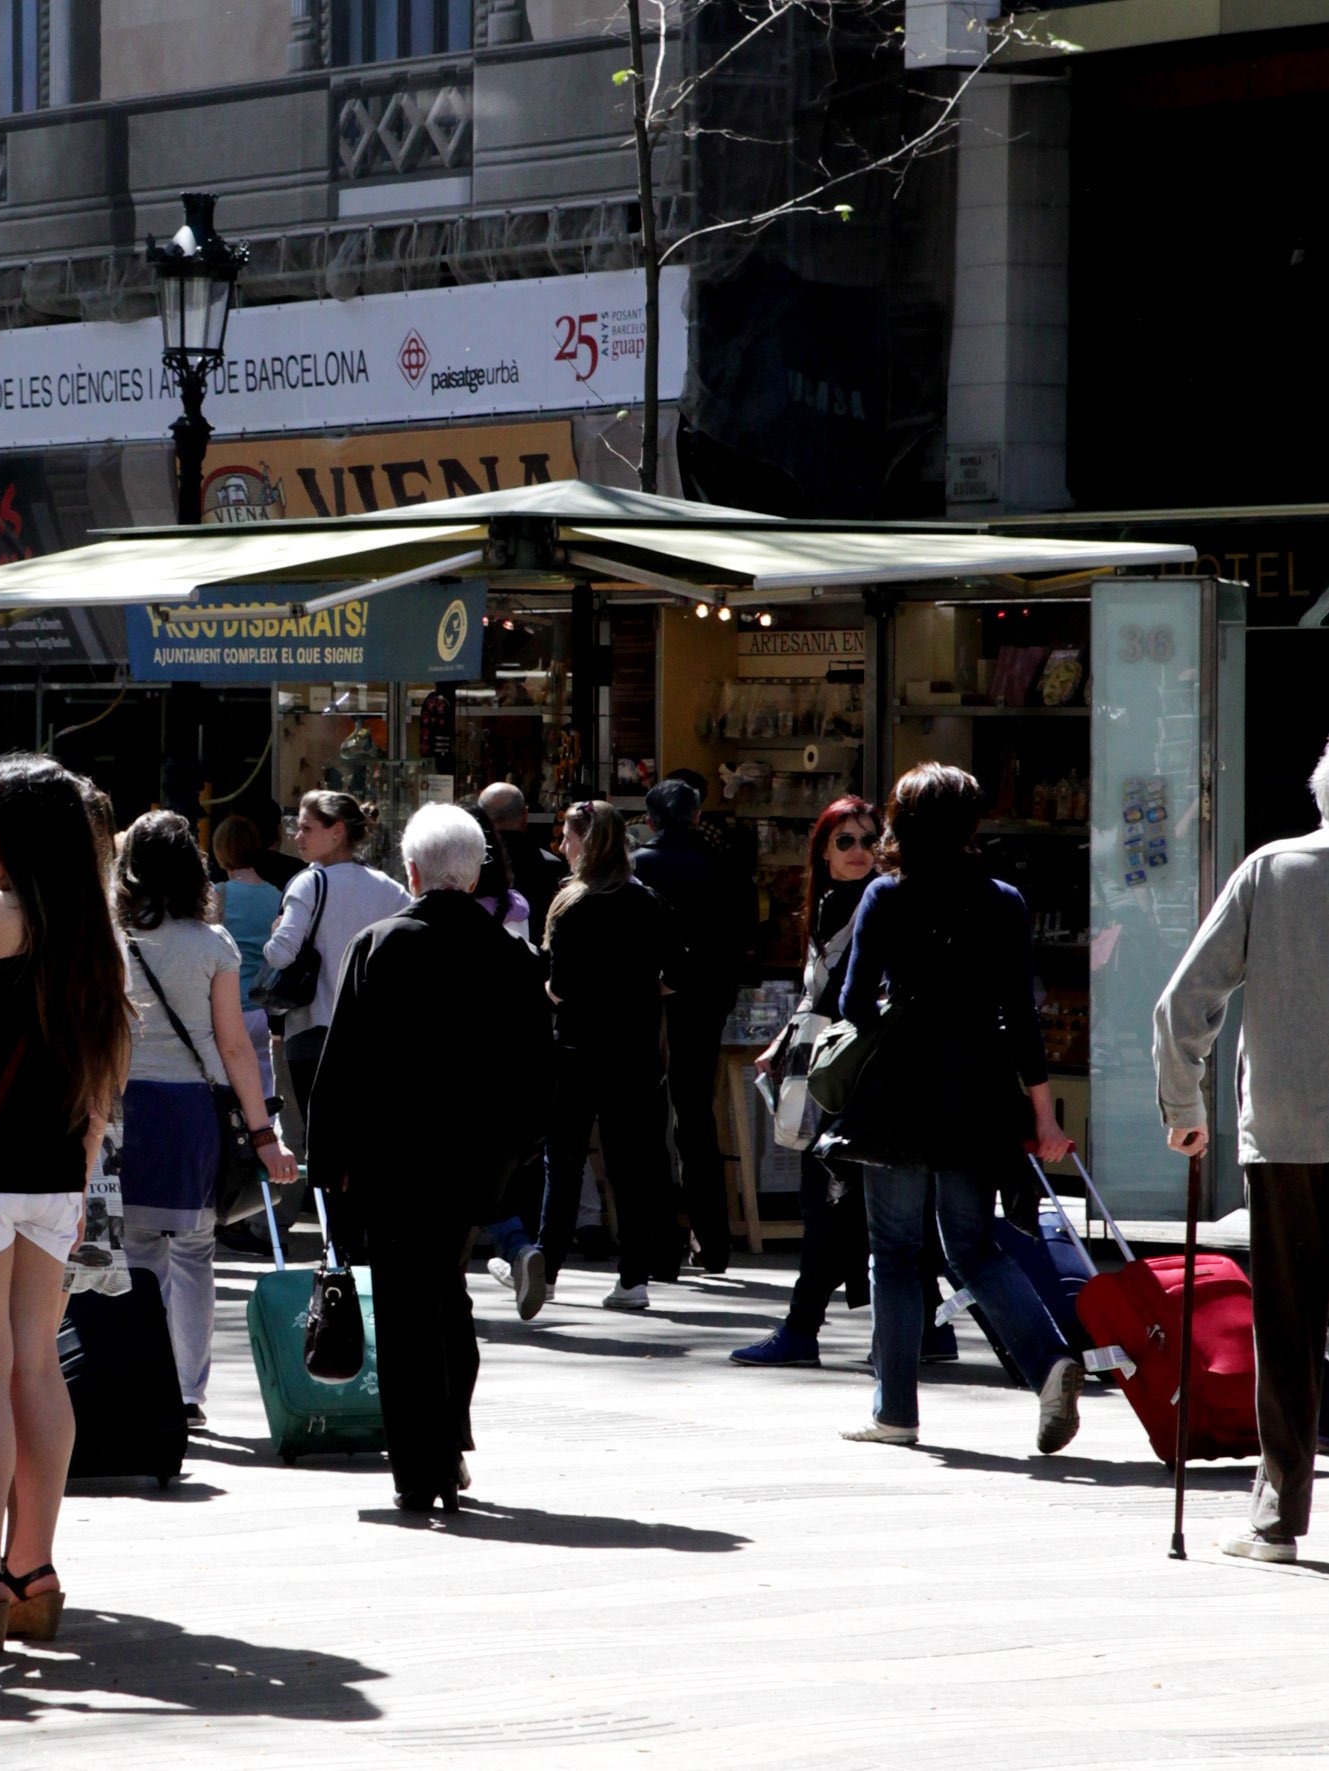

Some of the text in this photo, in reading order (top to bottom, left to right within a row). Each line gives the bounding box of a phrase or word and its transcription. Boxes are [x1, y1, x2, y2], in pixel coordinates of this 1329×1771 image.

[612, 309, 642, 321] POSANT
[612, 322, 646, 336] BARCELO
[555, 313, 598, 382] 25
[601, 311, 609, 356] ANYS
[611, 337, 645, 361] guap
[19, 375, 53, 409] LES
[58, 363, 143, 406] CIÈNCIES
[149, 367, 153, 400] I
[213, 361, 240, 395] DE
[245, 349, 370, 392] BARCELONA
[214, 505, 270, 523] VIENA
[1161, 552, 1311, 597] OTEL
[146, 601, 369, 638] PROU DISBARATS!
[154, 647, 364, 667] AJUNTAMENT COMPLEIX EL QUE SIGNES
[750, 632, 837, 653] ARTESANIA
[1120, 624, 1174, 664] 36
